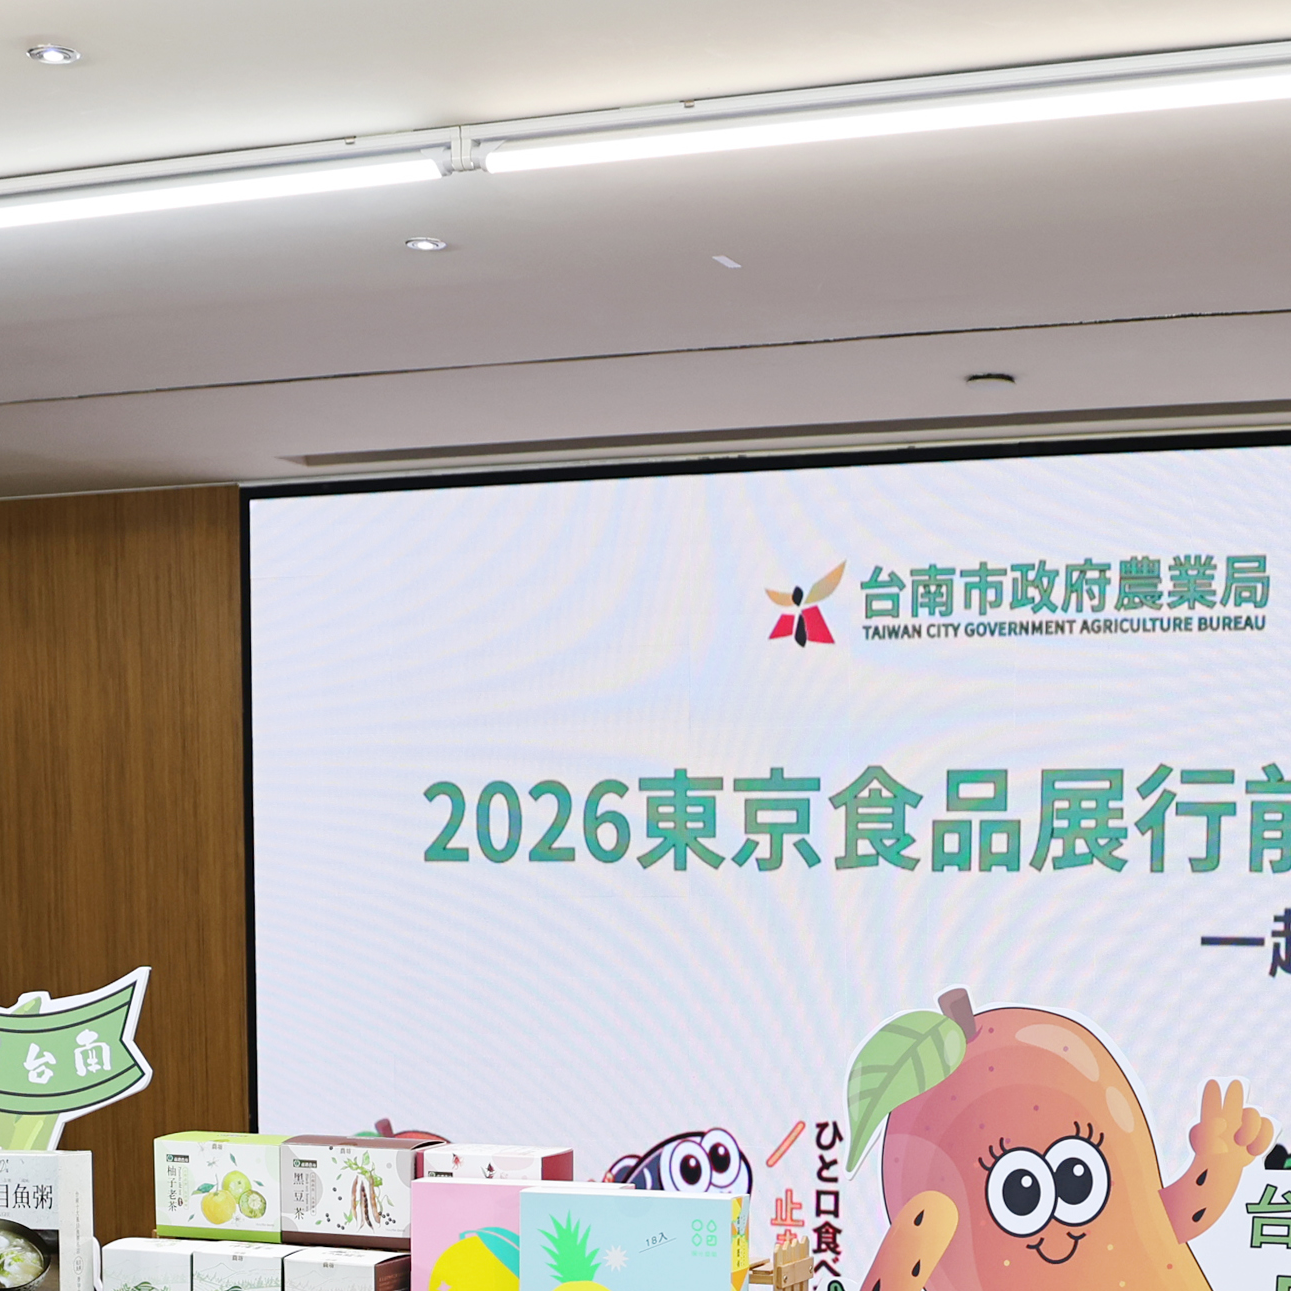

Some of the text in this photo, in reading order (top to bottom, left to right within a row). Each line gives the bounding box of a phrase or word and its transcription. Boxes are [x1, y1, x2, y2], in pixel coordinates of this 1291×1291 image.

[860, 554, 1271, 619] 台南市政府農業局
[863, 615, 1266, 640] TAIWAN CITY GOVERNMENT AGRICULTURE BUREAU
